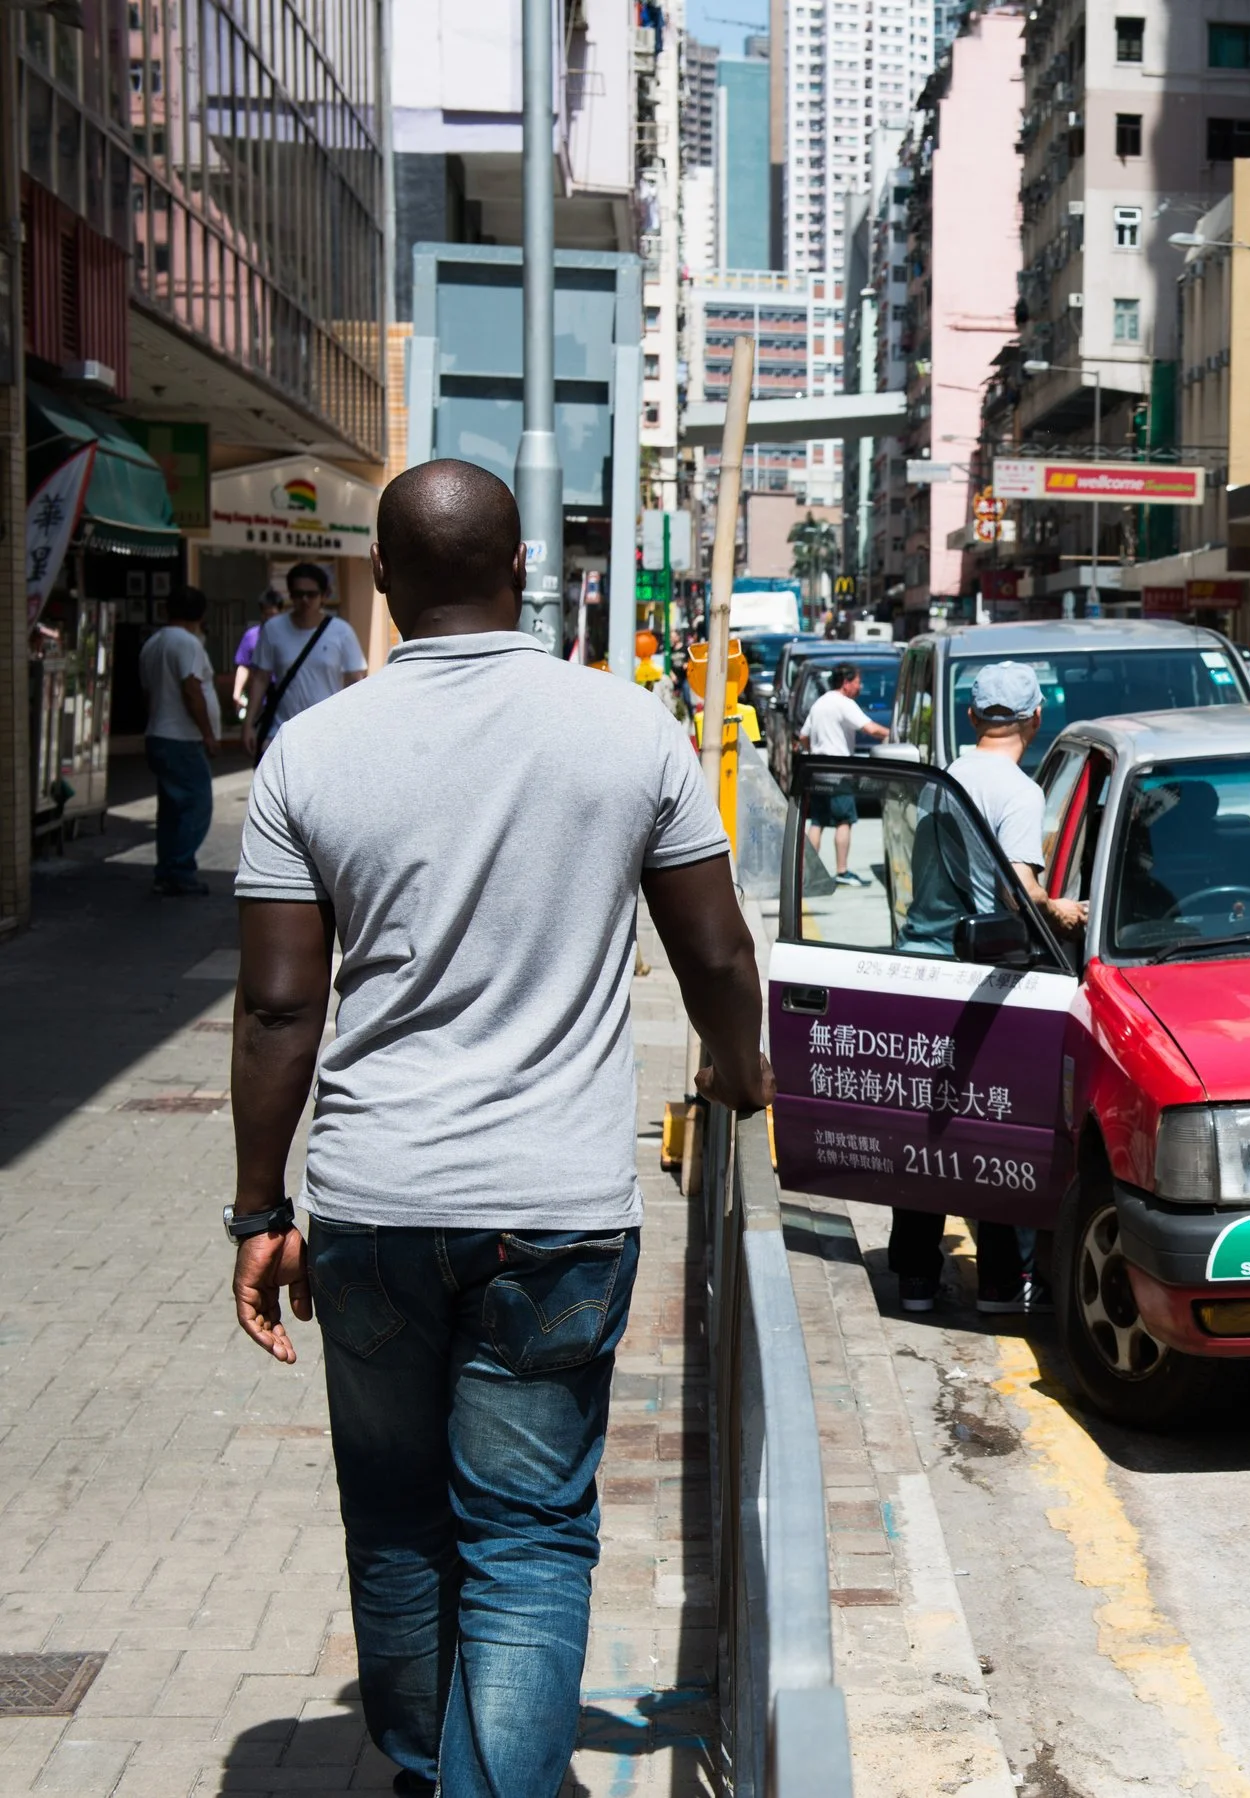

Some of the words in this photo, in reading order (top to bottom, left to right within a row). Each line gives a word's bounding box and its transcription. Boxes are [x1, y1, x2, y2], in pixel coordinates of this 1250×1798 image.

[856, 959, 883, 977] 92%
[808, 1019, 957, 1072] 無需DSE成績
[809, 1062, 1013, 1121] 銜接海外頂尖大學
[902, 1143, 964, 1181] 2111
[971, 1154, 1038, 1192] 2388
